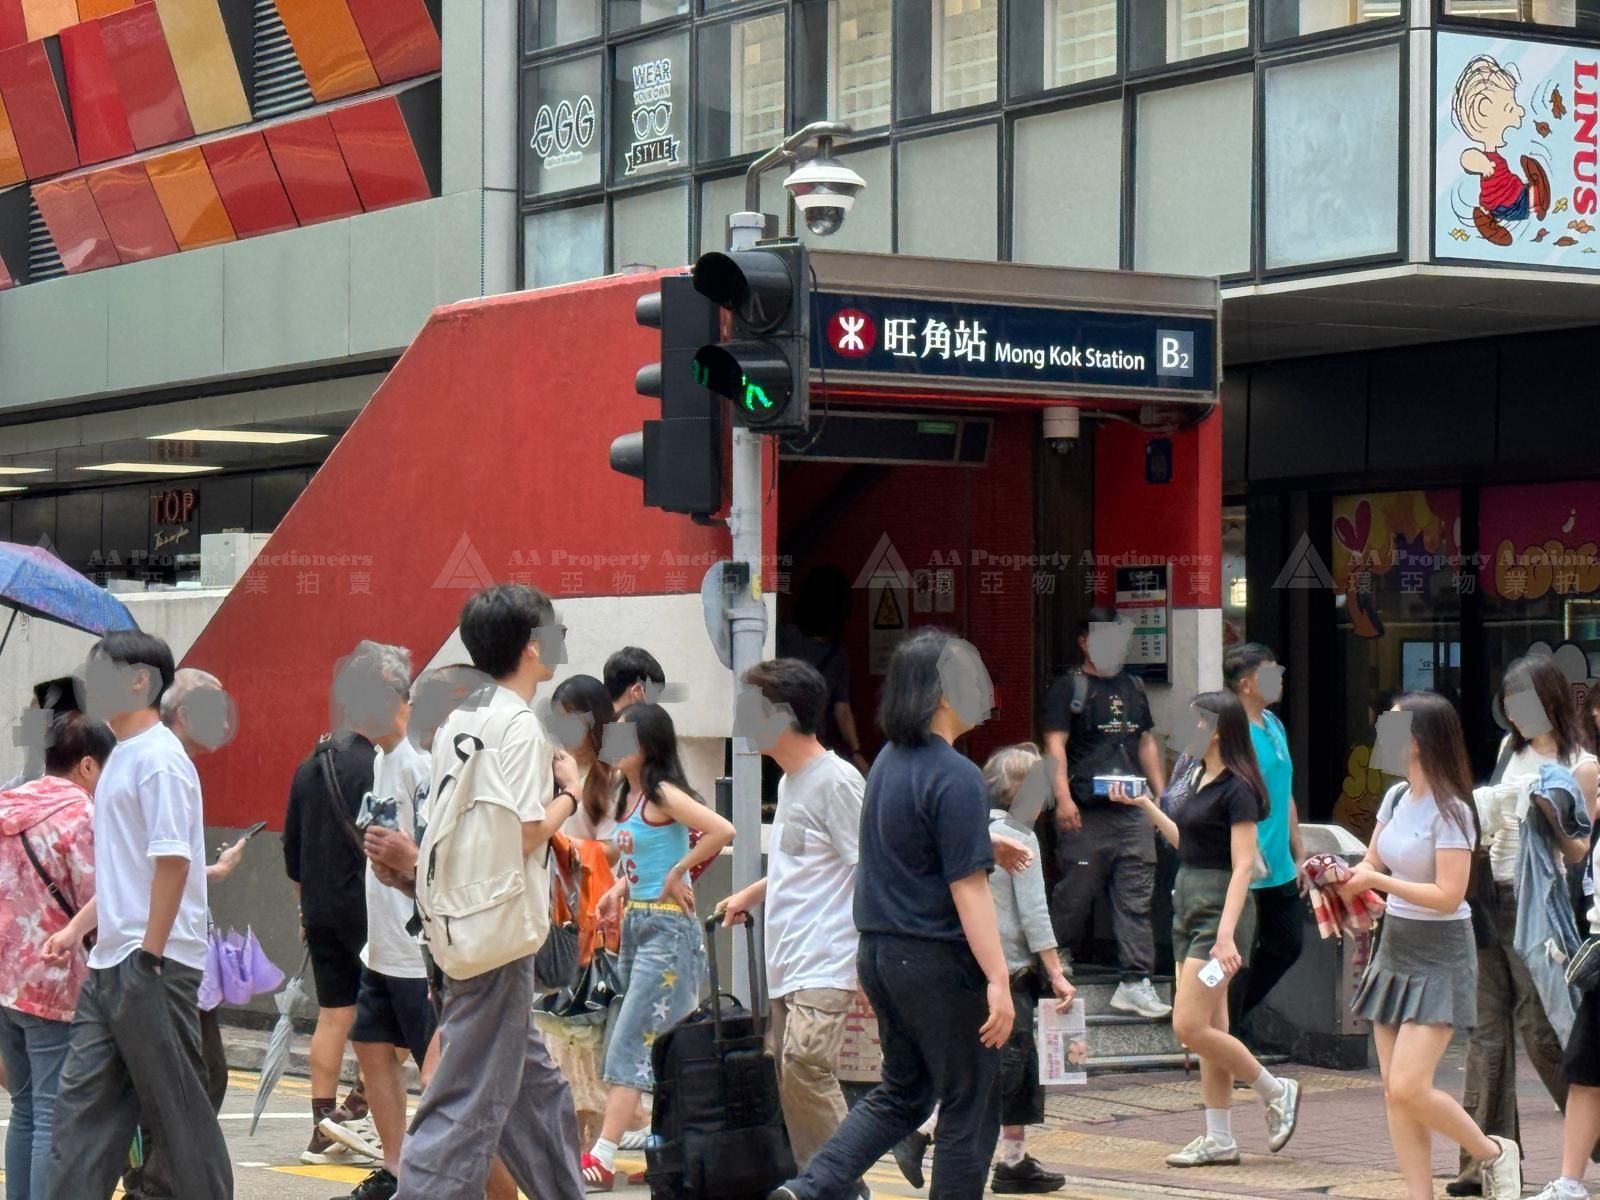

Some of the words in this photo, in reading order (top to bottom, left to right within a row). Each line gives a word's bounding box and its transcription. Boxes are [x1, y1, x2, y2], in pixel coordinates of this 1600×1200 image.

[633, 58, 671, 89] WEAR
[636, 139, 670, 163] STYLE
[1574, 60, 1598, 215] LINUS
[884, 317, 988, 362] 旺角站
[1162, 337, 1189, 369] B2
[995, 342, 1045, 370] Mong
[1049, 345, 1082, 367] Kok
[1085, 348, 1145, 370] Station
